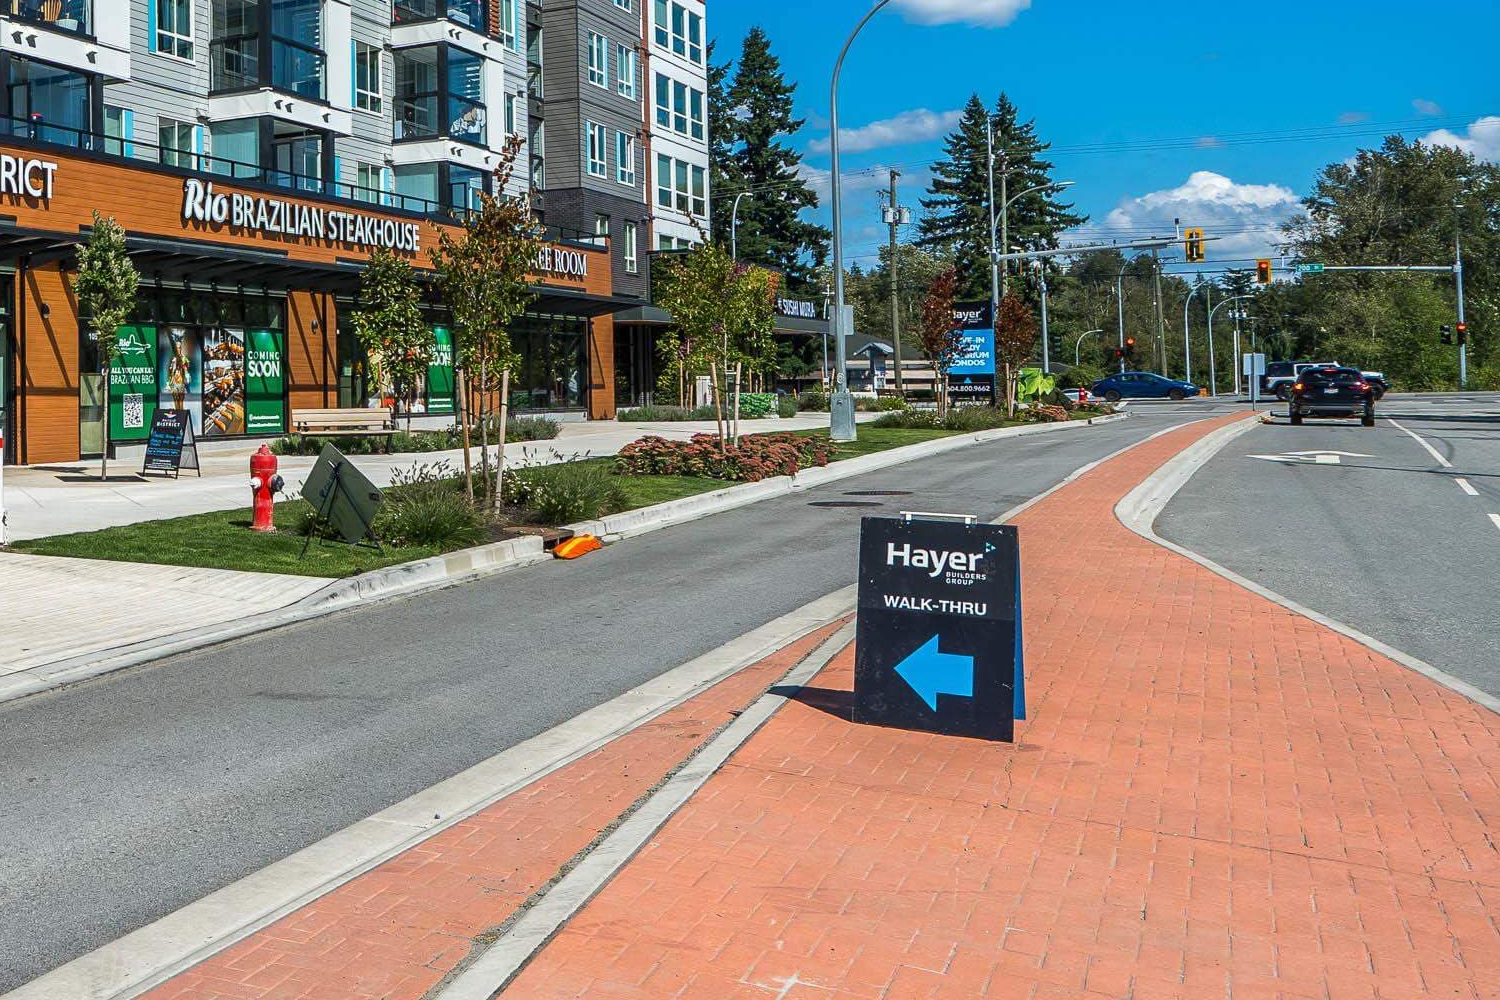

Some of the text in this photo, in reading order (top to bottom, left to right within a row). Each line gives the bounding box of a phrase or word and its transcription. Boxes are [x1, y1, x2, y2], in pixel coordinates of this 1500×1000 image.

[184, 178, 421, 251] Rio BRAZILIAN STEAKHOUSE
[554, 249, 588, 276] ROOM
[247, 350, 280, 361] COMING
[111, 366, 122, 374] ALL
[248, 360, 280, 378] SOON
[111, 374, 141, 385] BRAZAN
[886, 542, 984, 578] Hayer
[945, 571, 987, 581] BUILDERS
[945, 578, 974, 586] GROUP
[883, 594, 987, 616] WALK-THRU
